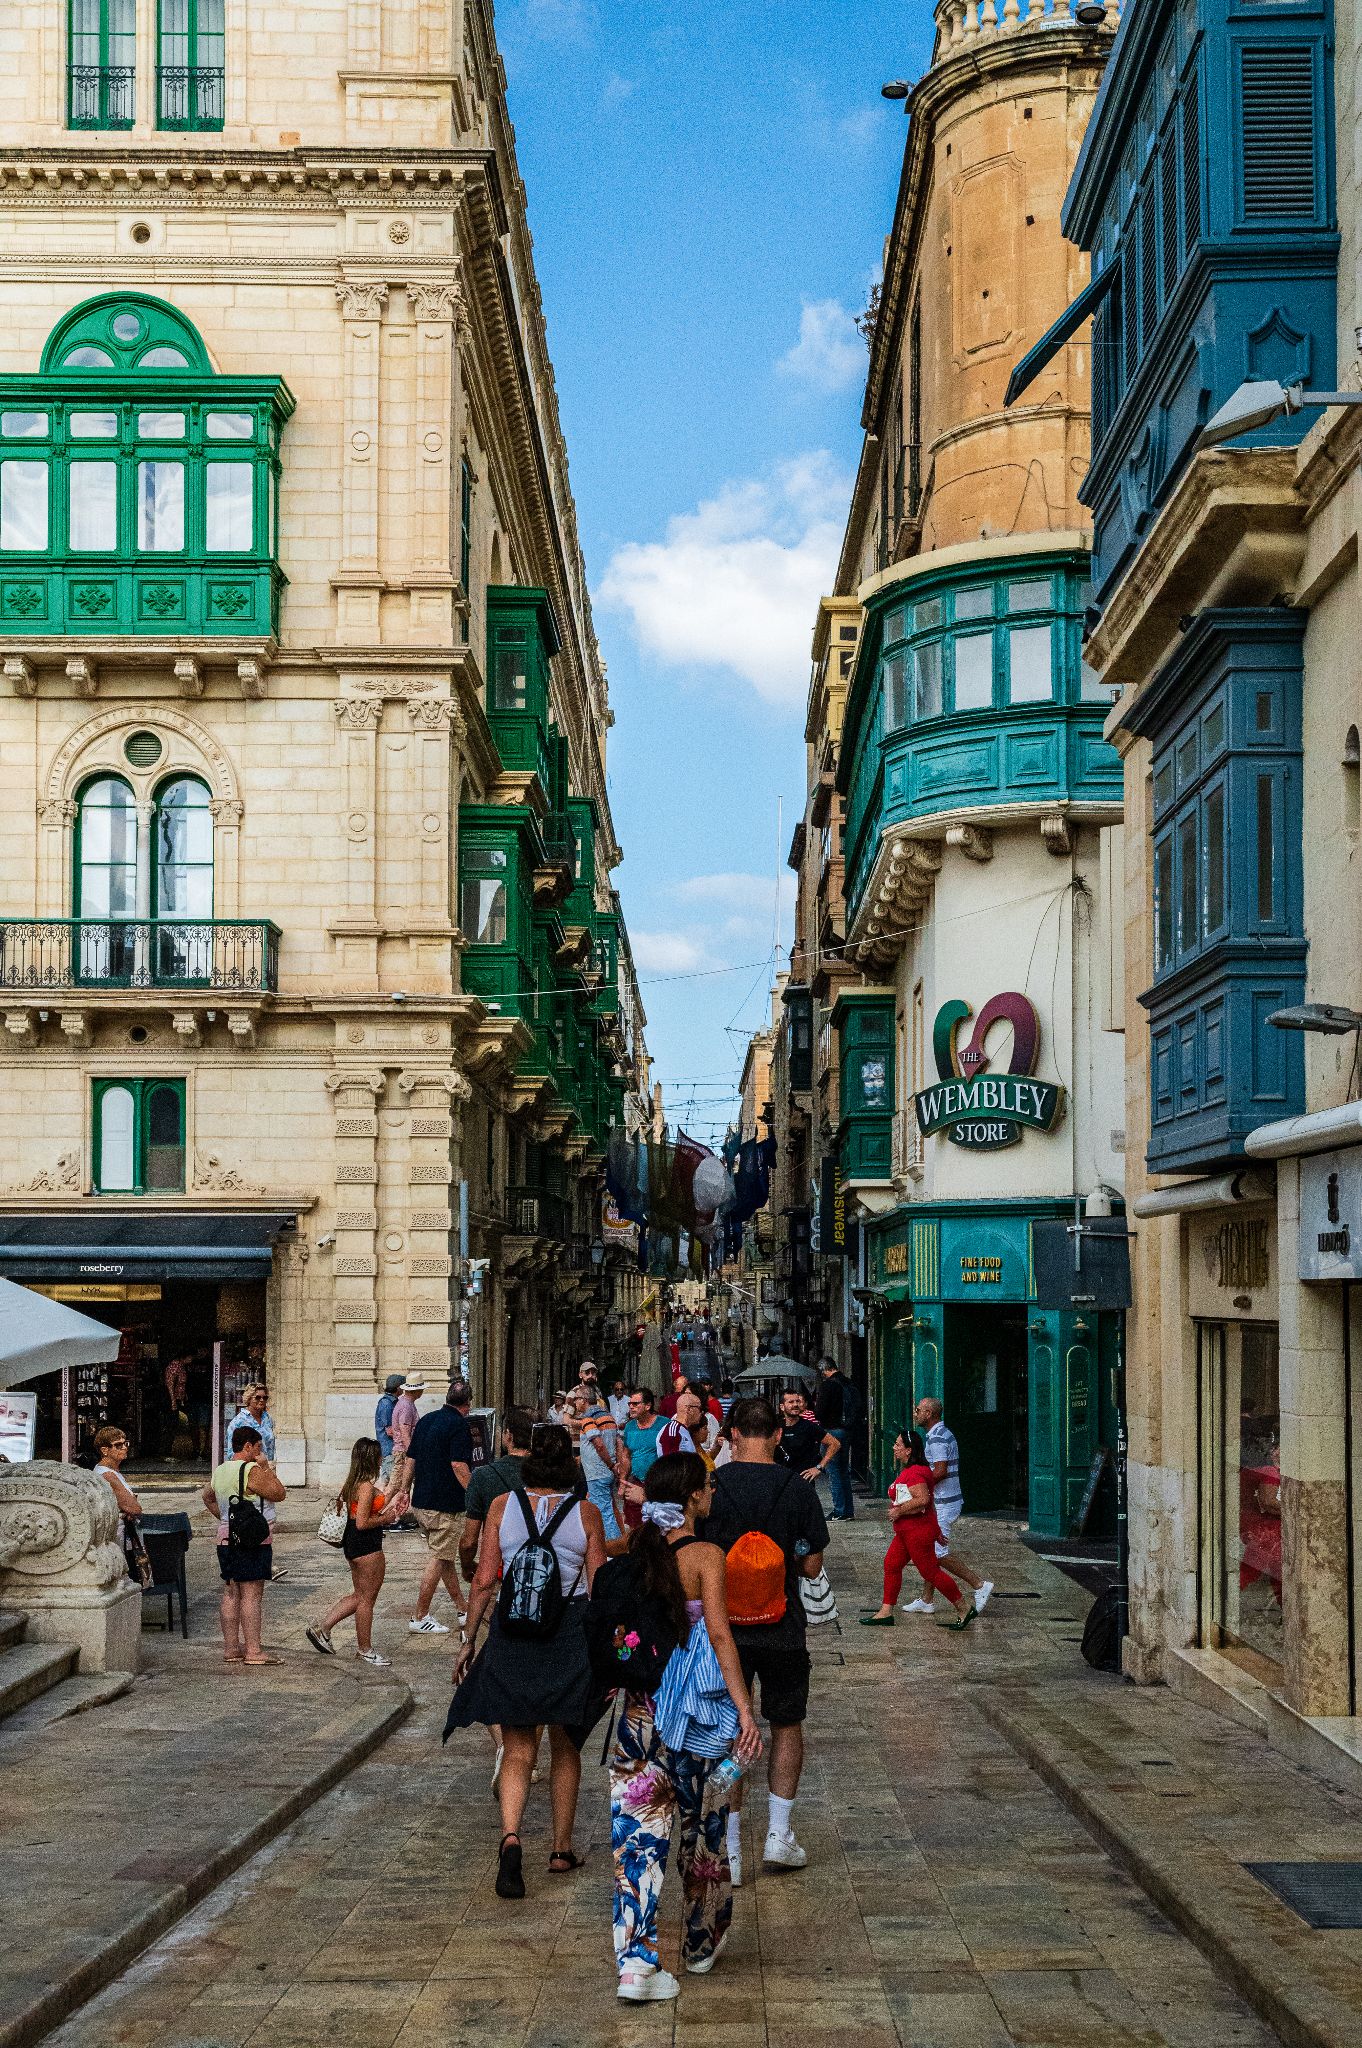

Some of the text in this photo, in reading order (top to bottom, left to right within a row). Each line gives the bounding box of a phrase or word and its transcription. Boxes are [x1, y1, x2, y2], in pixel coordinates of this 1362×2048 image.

[961, 1052, 979, 1062] THE
[919, 1081, 1049, 1125] WEMBLEY
[956, 1123, 1008, 1142] STORE
[960, 1256, 1001, 1268] FINE FOOD
[80, 1263, 124, 1275] roseberry
[961, 1270, 1000, 1282] AND WINE
